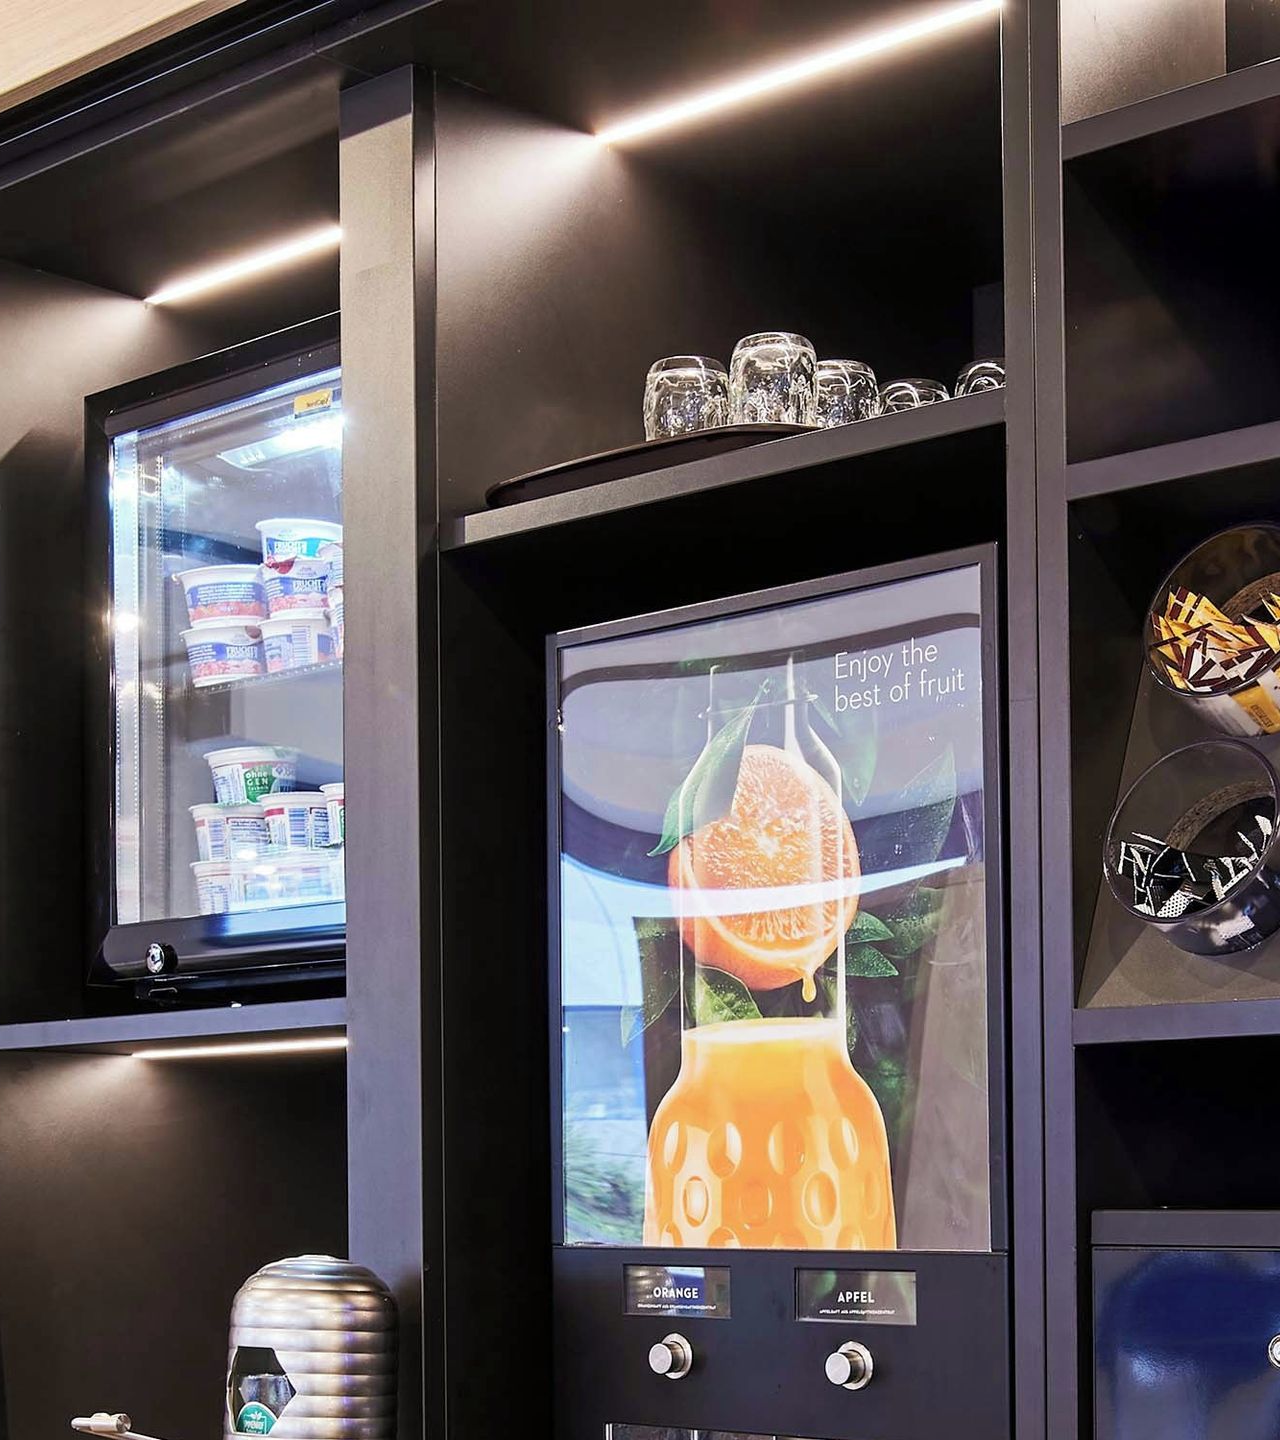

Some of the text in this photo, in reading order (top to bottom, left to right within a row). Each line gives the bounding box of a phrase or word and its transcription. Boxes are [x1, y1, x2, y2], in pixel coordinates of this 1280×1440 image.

[835, 637, 938, 682] Enjoy the
[835, 667, 966, 713] best of fruit
[653, 1287, 699, 1299] ORANGE
[837, 1291, 875, 1304] APFEL
